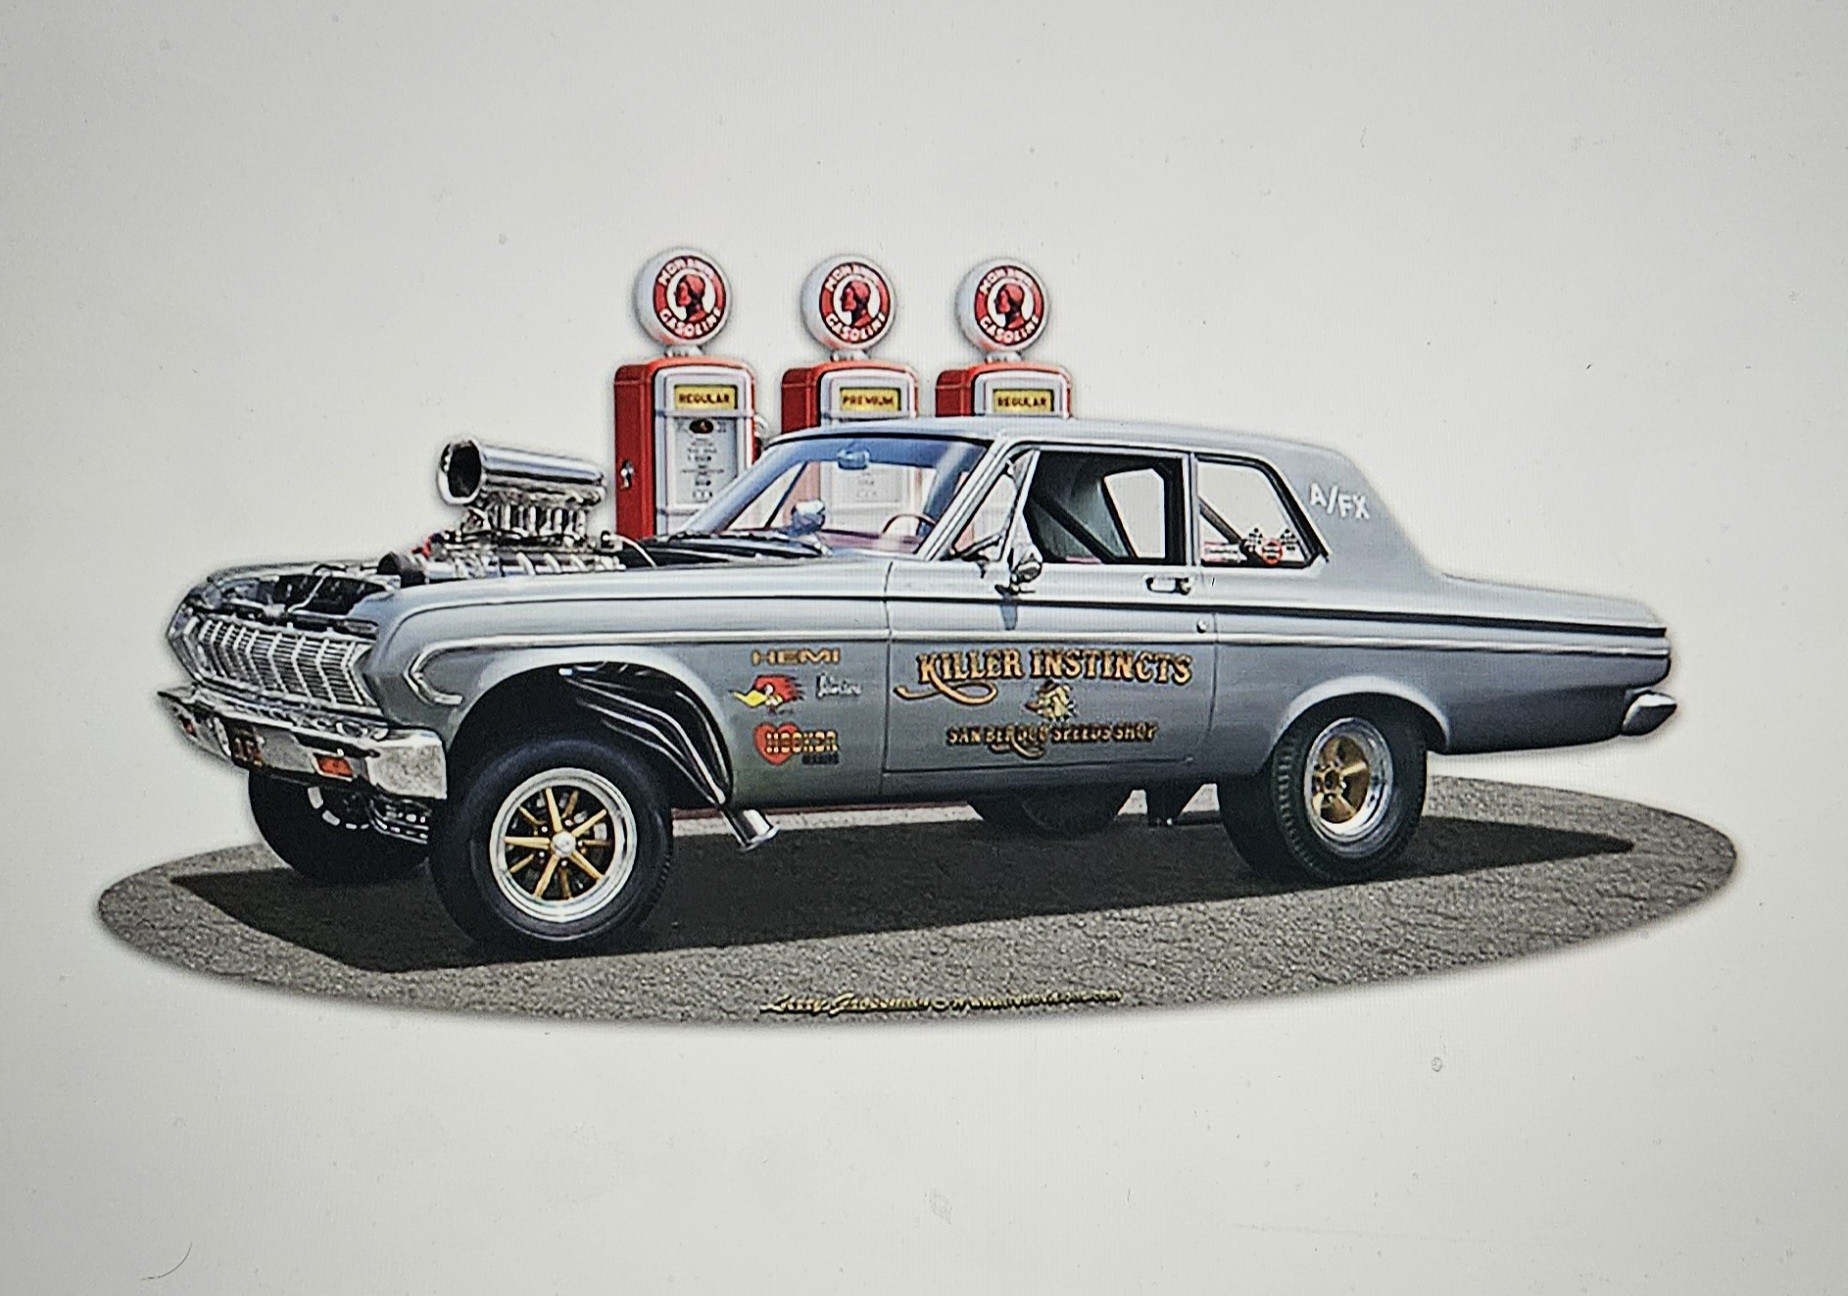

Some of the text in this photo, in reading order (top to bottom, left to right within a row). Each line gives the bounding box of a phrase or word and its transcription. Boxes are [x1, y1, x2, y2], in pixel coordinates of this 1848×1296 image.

[659, 307, 721, 338] GASOLINE
[826, 312, 886, 342] GASOLINE
[979, 314, 1039, 344] GASOLINE
[679, 393, 730, 404] REGULAR
[843, 395, 893, 406] PREMIUM
[997, 396, 1047, 407] REGULAR
[1309, 482, 1371, 520] A/FX
[751, 647, 841, 666] HEMI
[1031, 647, 1194, 685] INSTINCTS
[946, 725, 981, 746] SAN
[1113, 721, 1159, 742] SHOP
